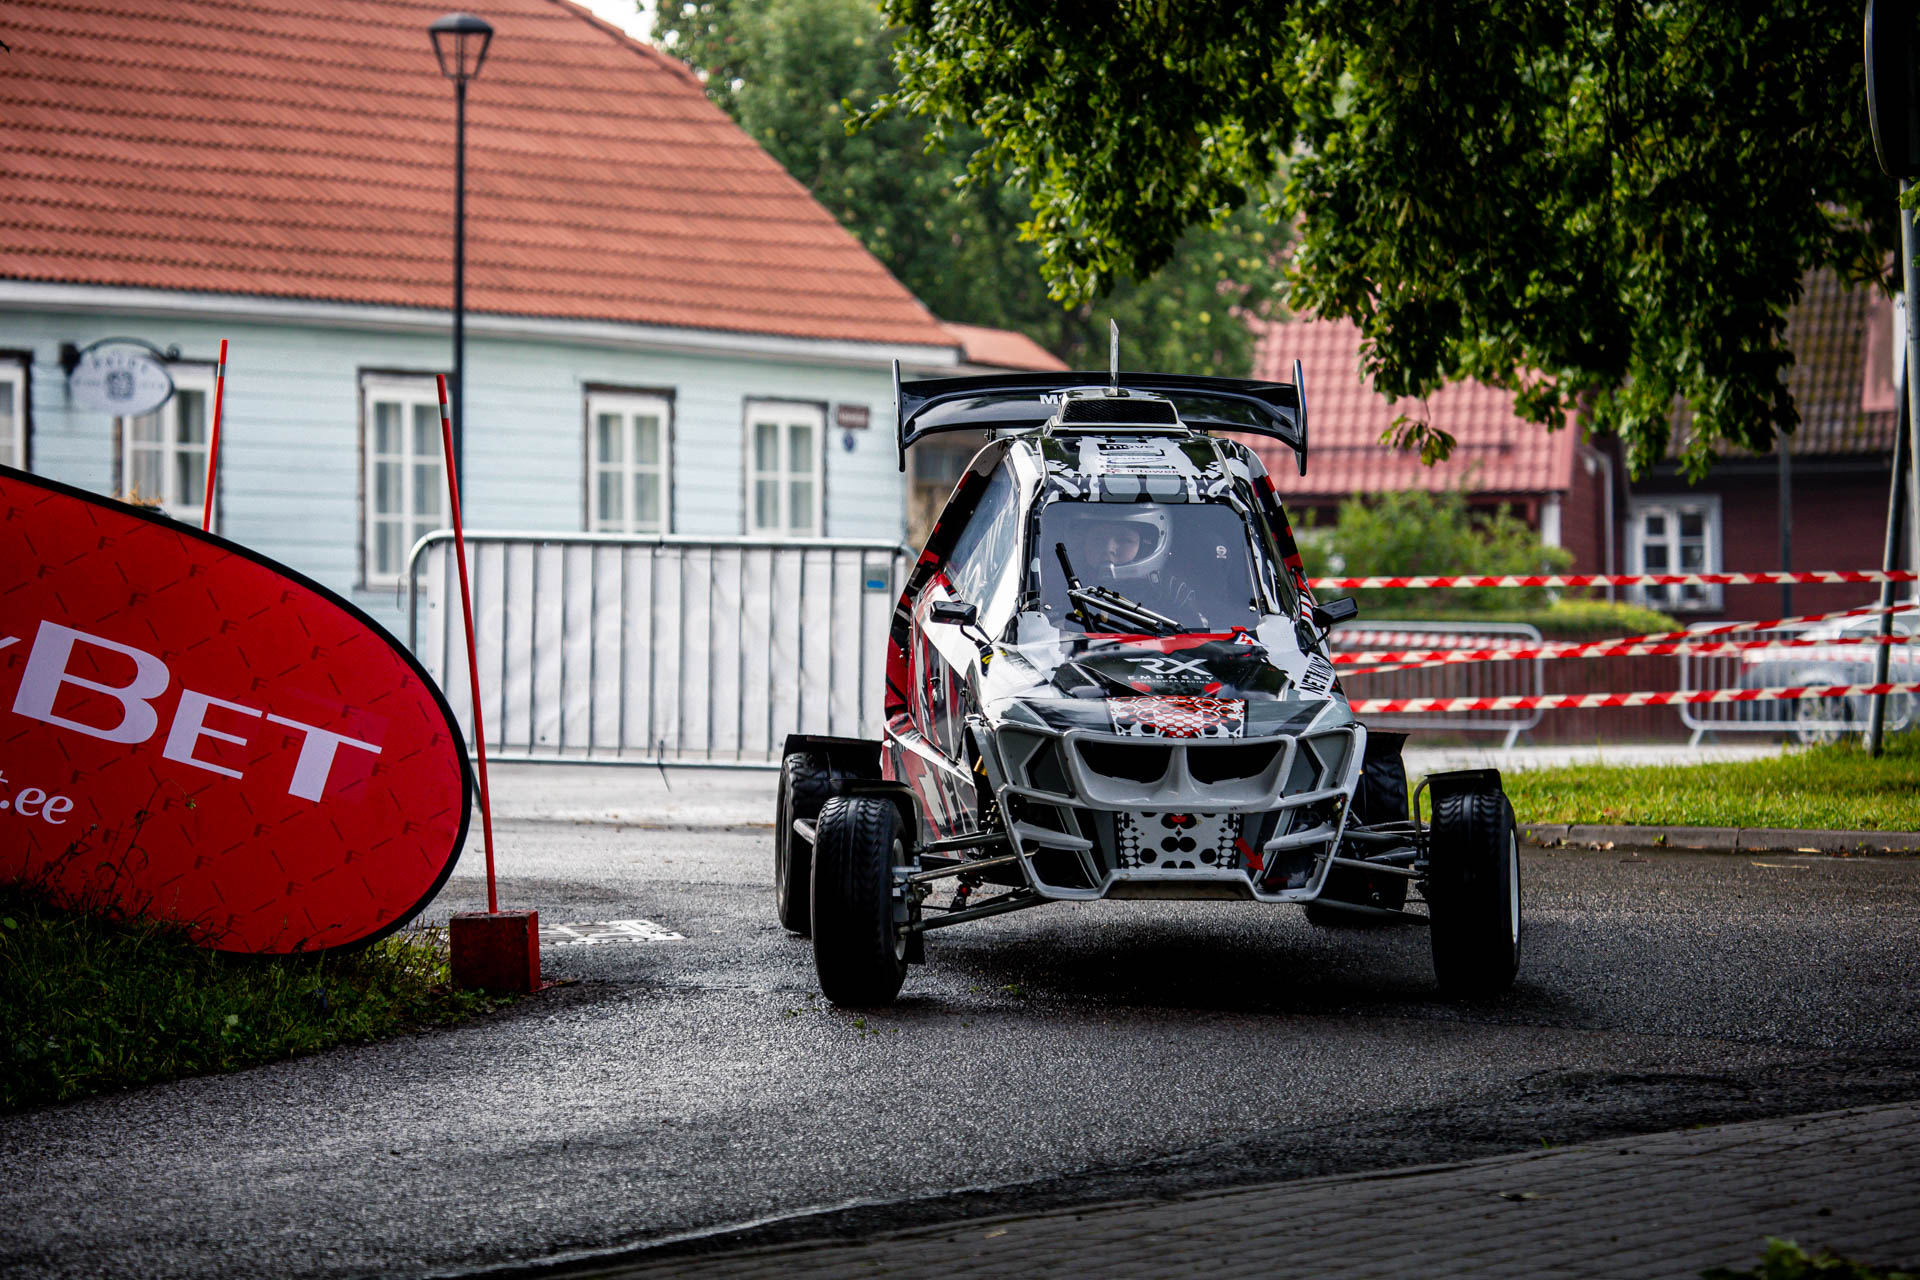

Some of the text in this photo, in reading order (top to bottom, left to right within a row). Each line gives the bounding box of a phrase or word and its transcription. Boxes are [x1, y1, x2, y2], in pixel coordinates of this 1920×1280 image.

[1123, 657, 1213, 676] RX
[0, 619, 382, 803] BET
[0, 770, 74, 824] .ee
